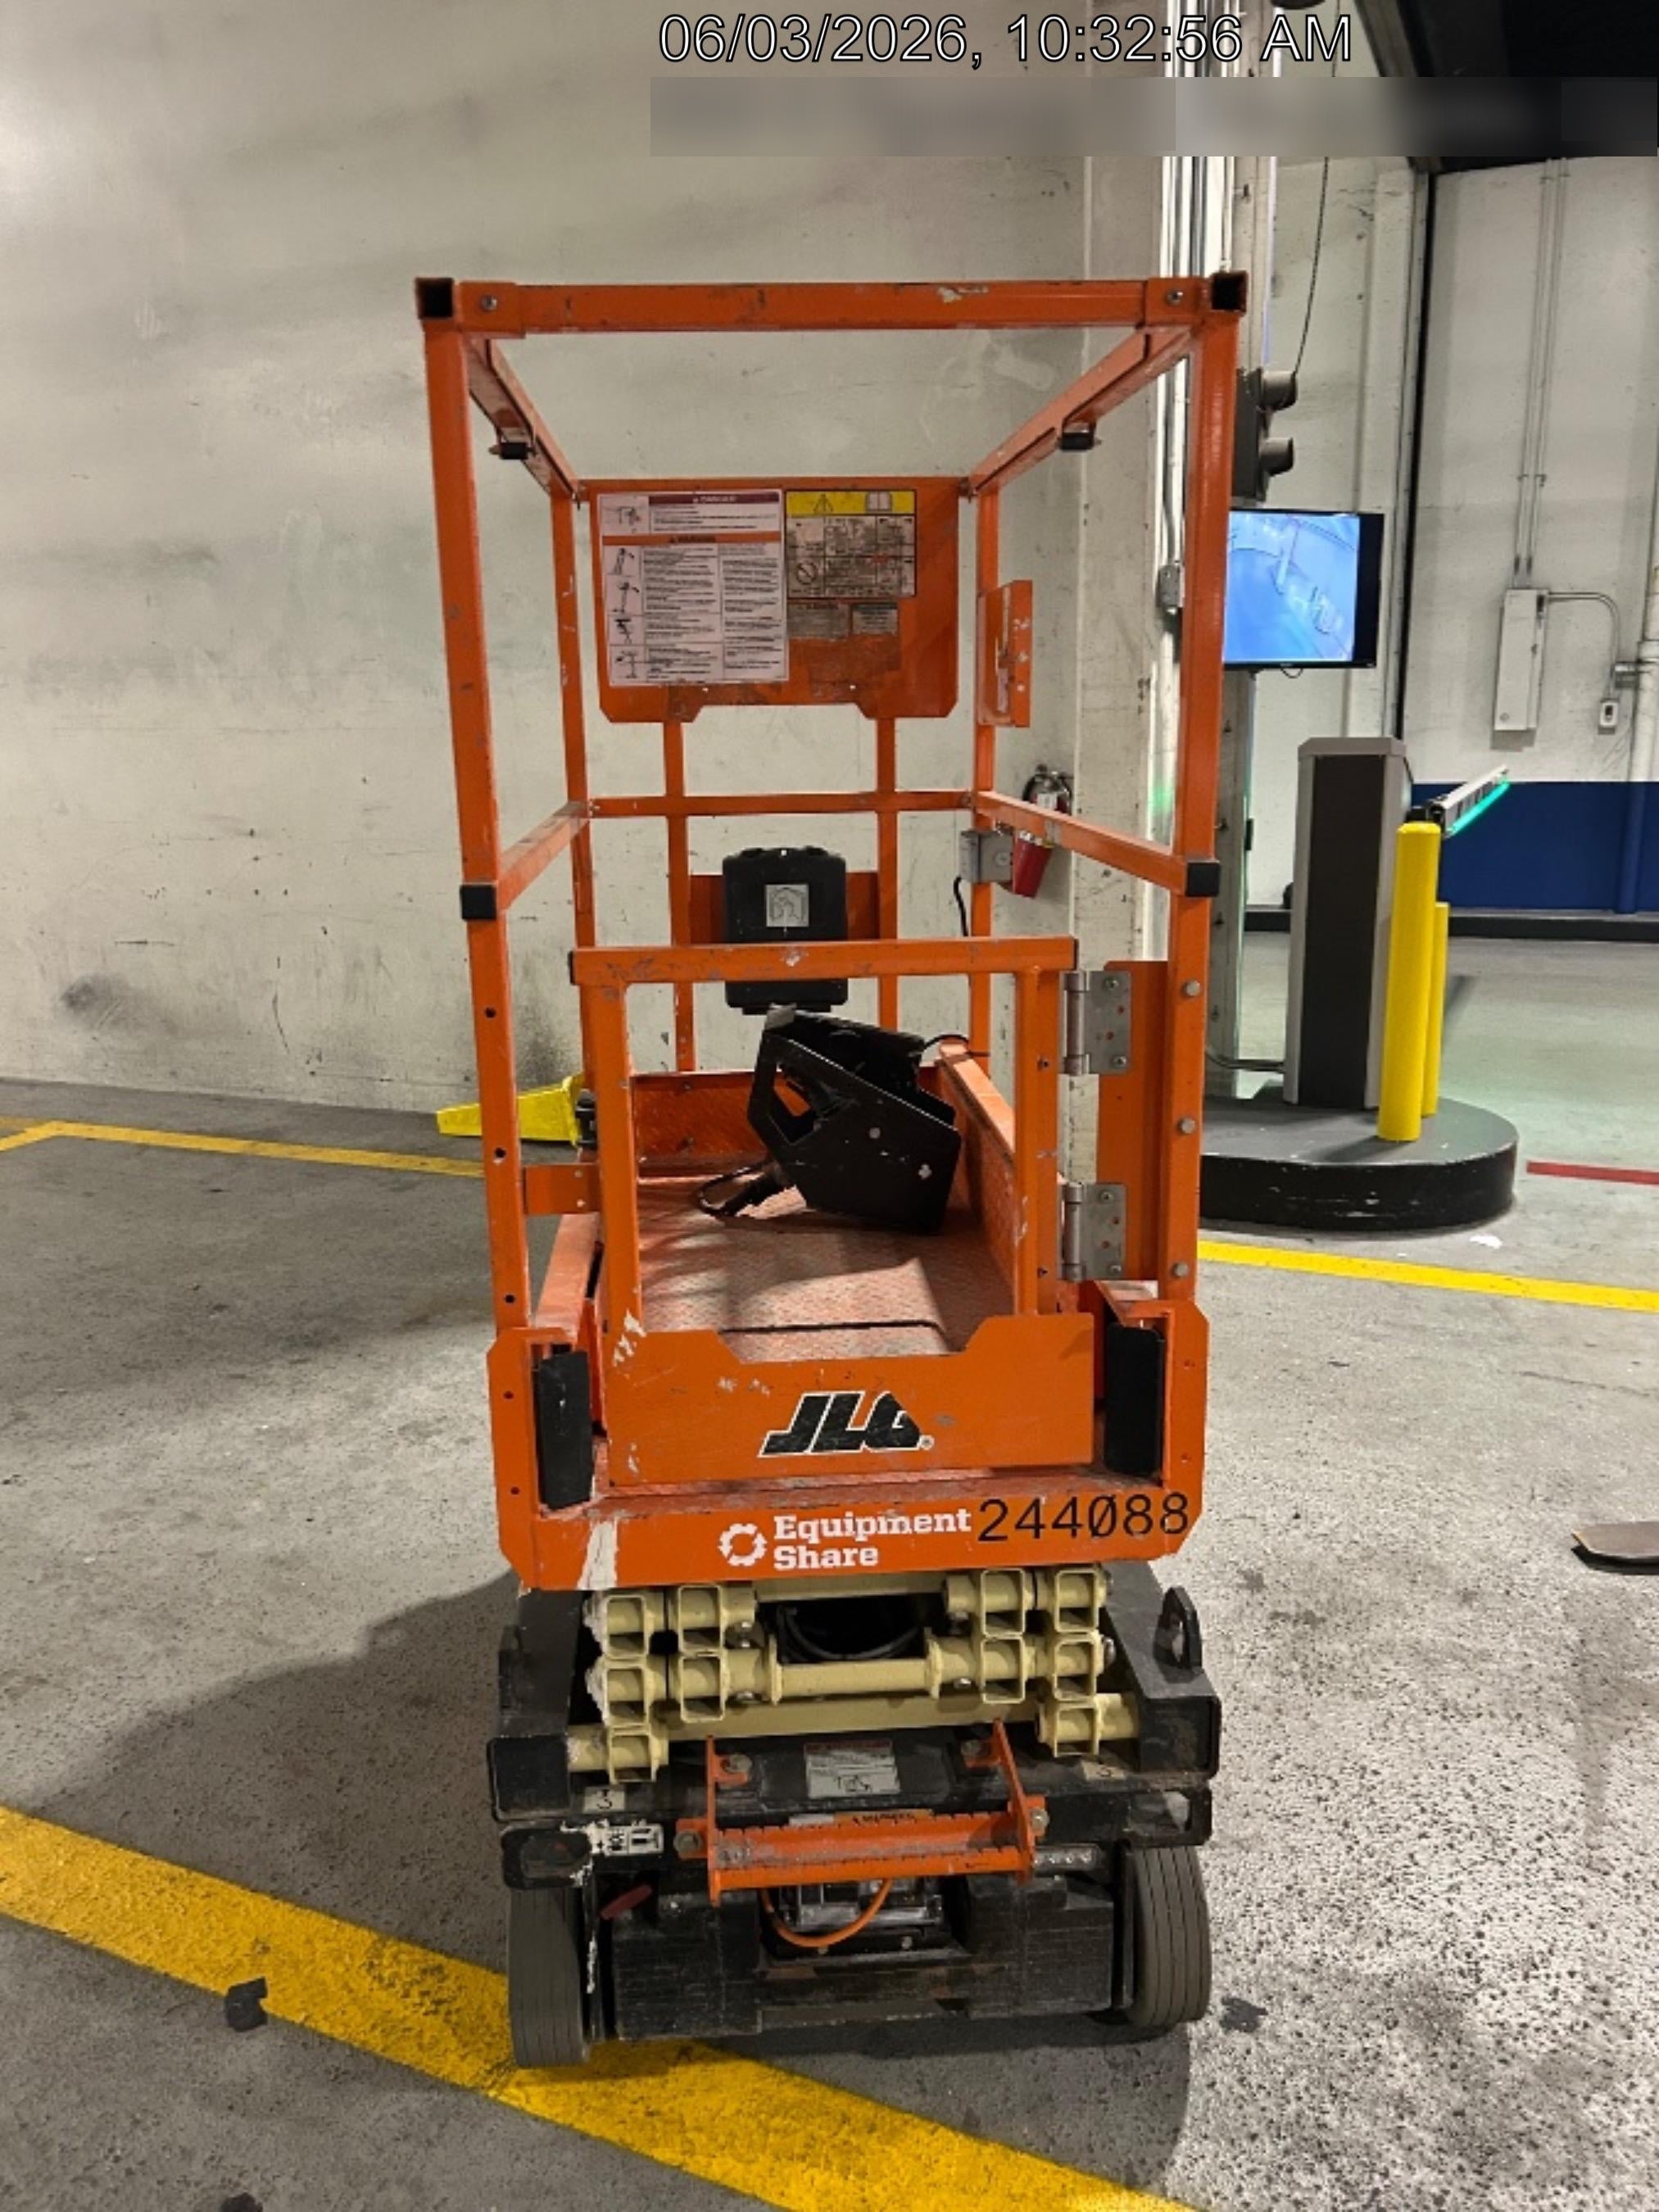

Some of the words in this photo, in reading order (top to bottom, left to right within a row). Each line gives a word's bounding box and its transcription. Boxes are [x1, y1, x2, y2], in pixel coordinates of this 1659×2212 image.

[758, 1390, 924, 1457] JLG
[773, 1508, 972, 1543] Equipment
[977, 1491, 1190, 1543] 244088
[773, 1545, 879, 1571] Share
